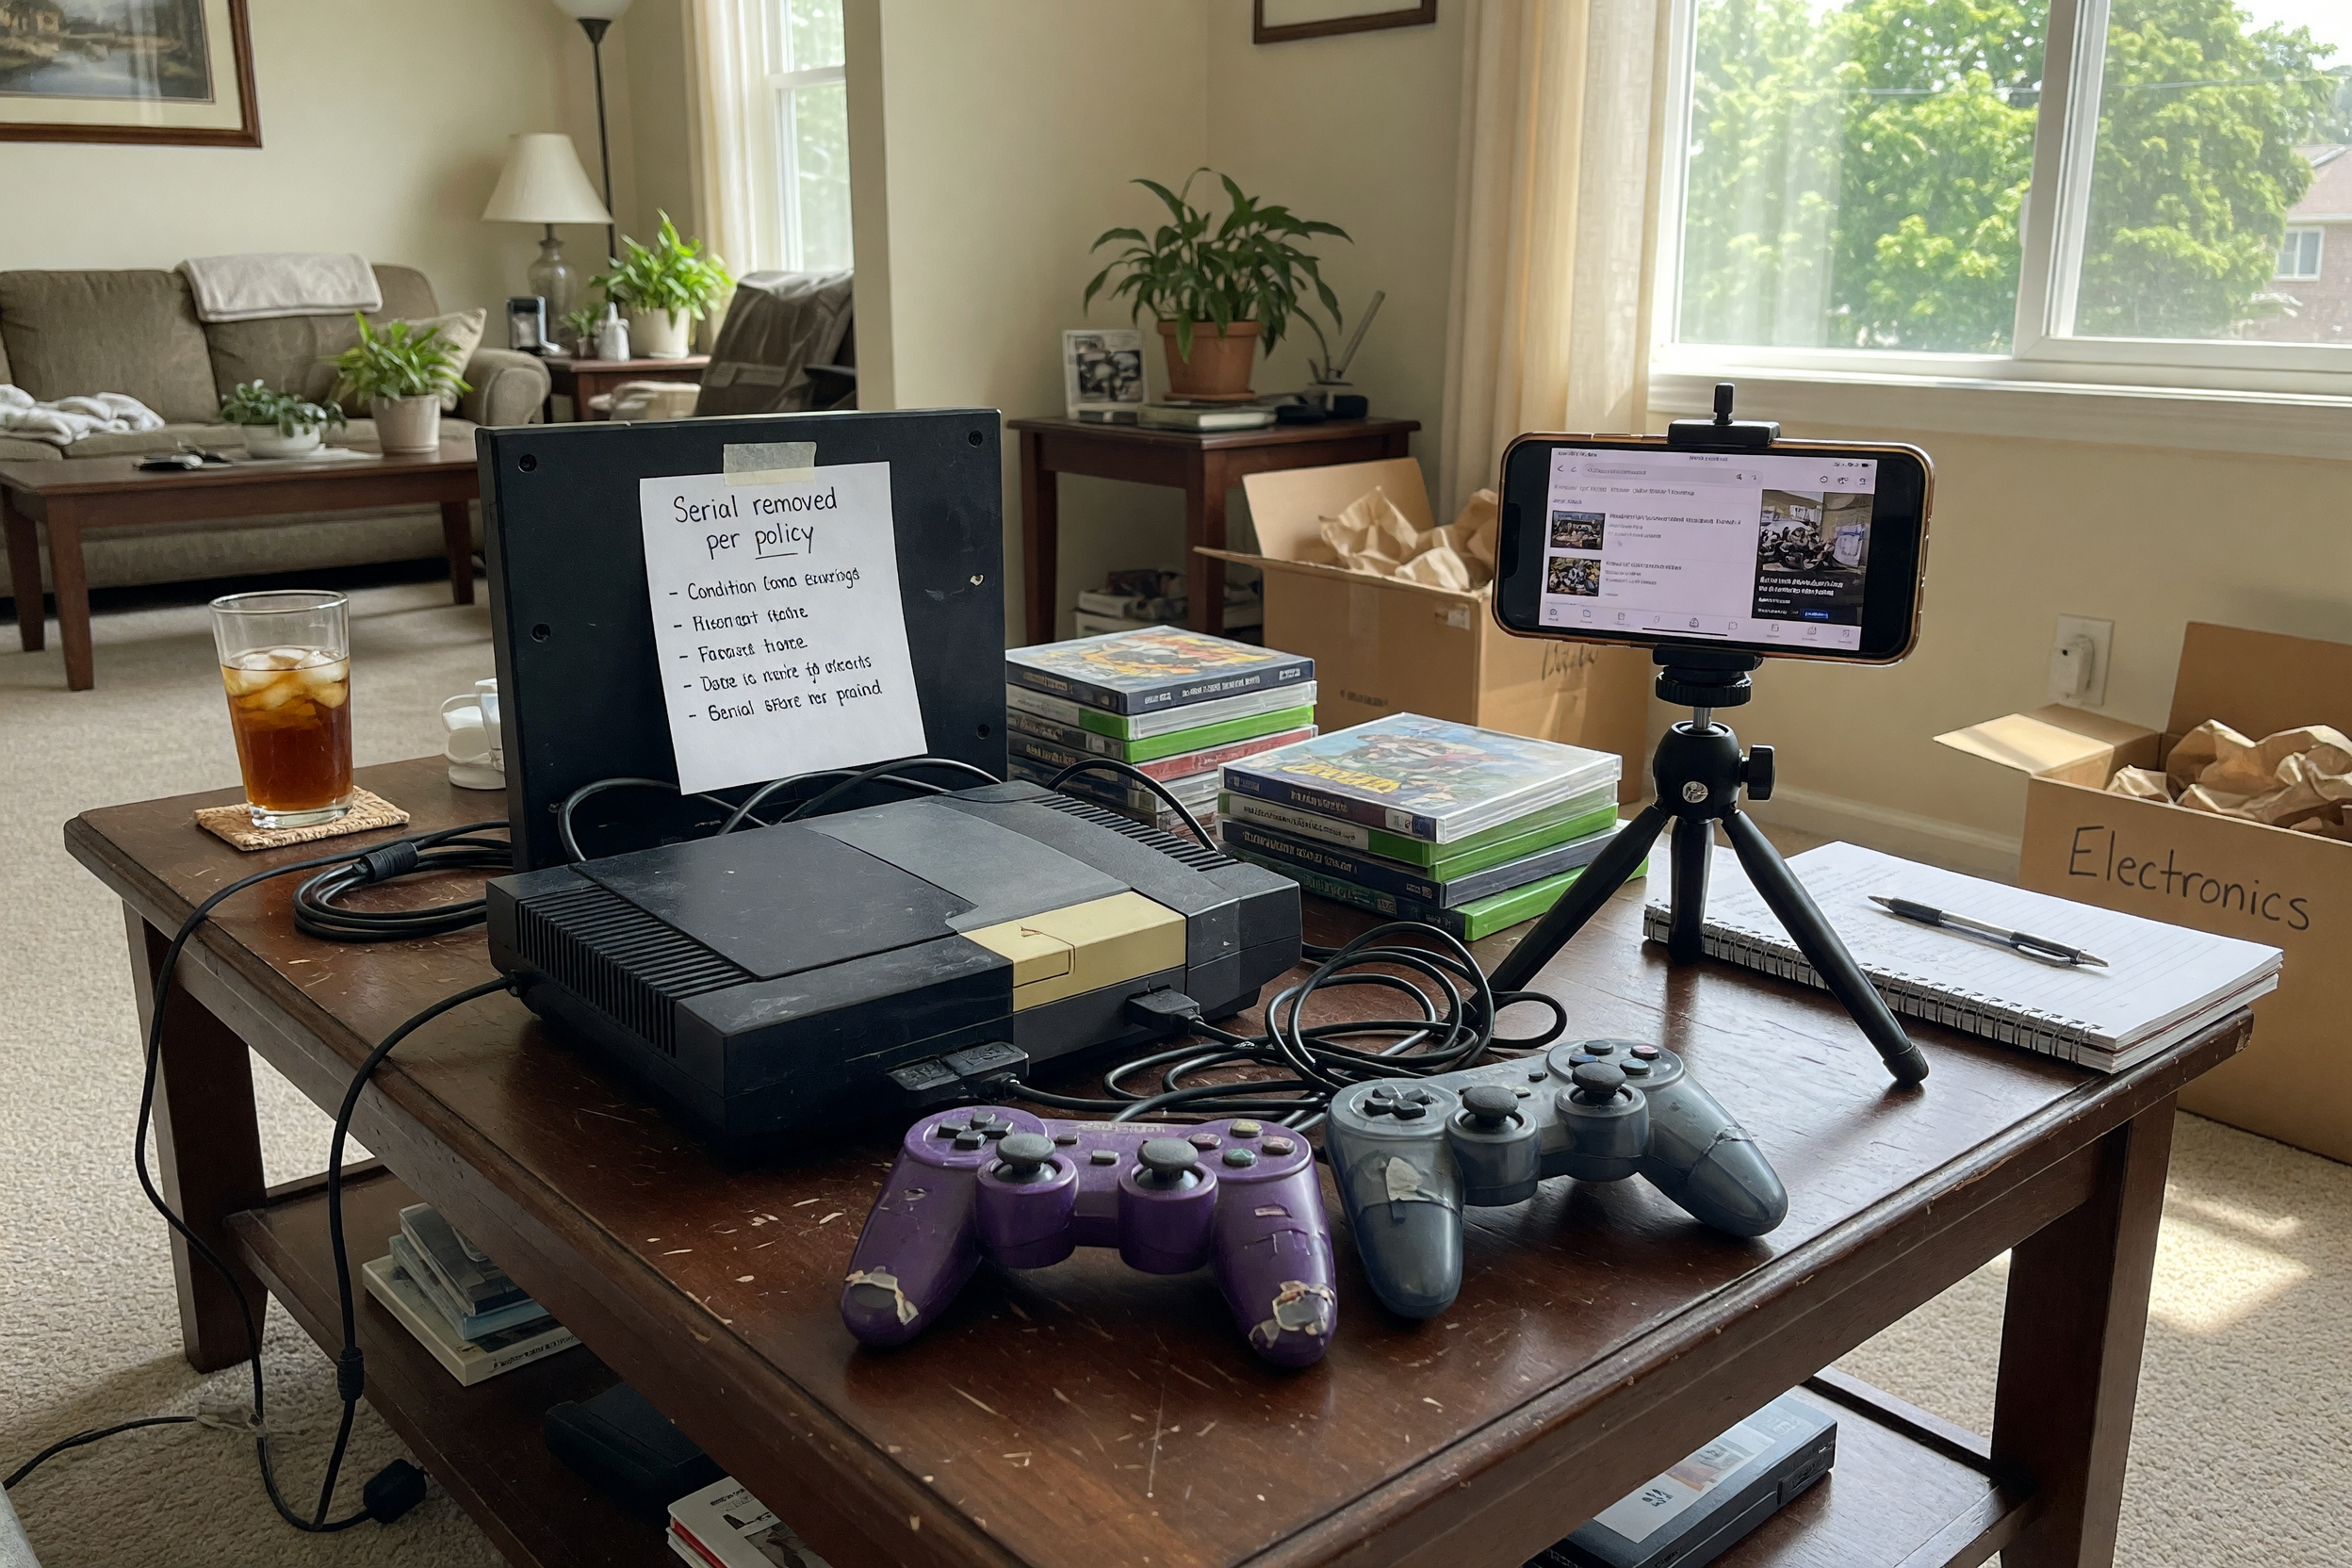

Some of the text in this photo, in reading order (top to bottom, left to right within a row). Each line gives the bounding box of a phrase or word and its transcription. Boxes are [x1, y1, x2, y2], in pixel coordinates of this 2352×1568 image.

[673, 485, 838, 523] Serial removed
[706, 522, 814, 561] per policy
[687, 580, 757, 600] Condition
[2068, 825, 2311, 931] Electronics
